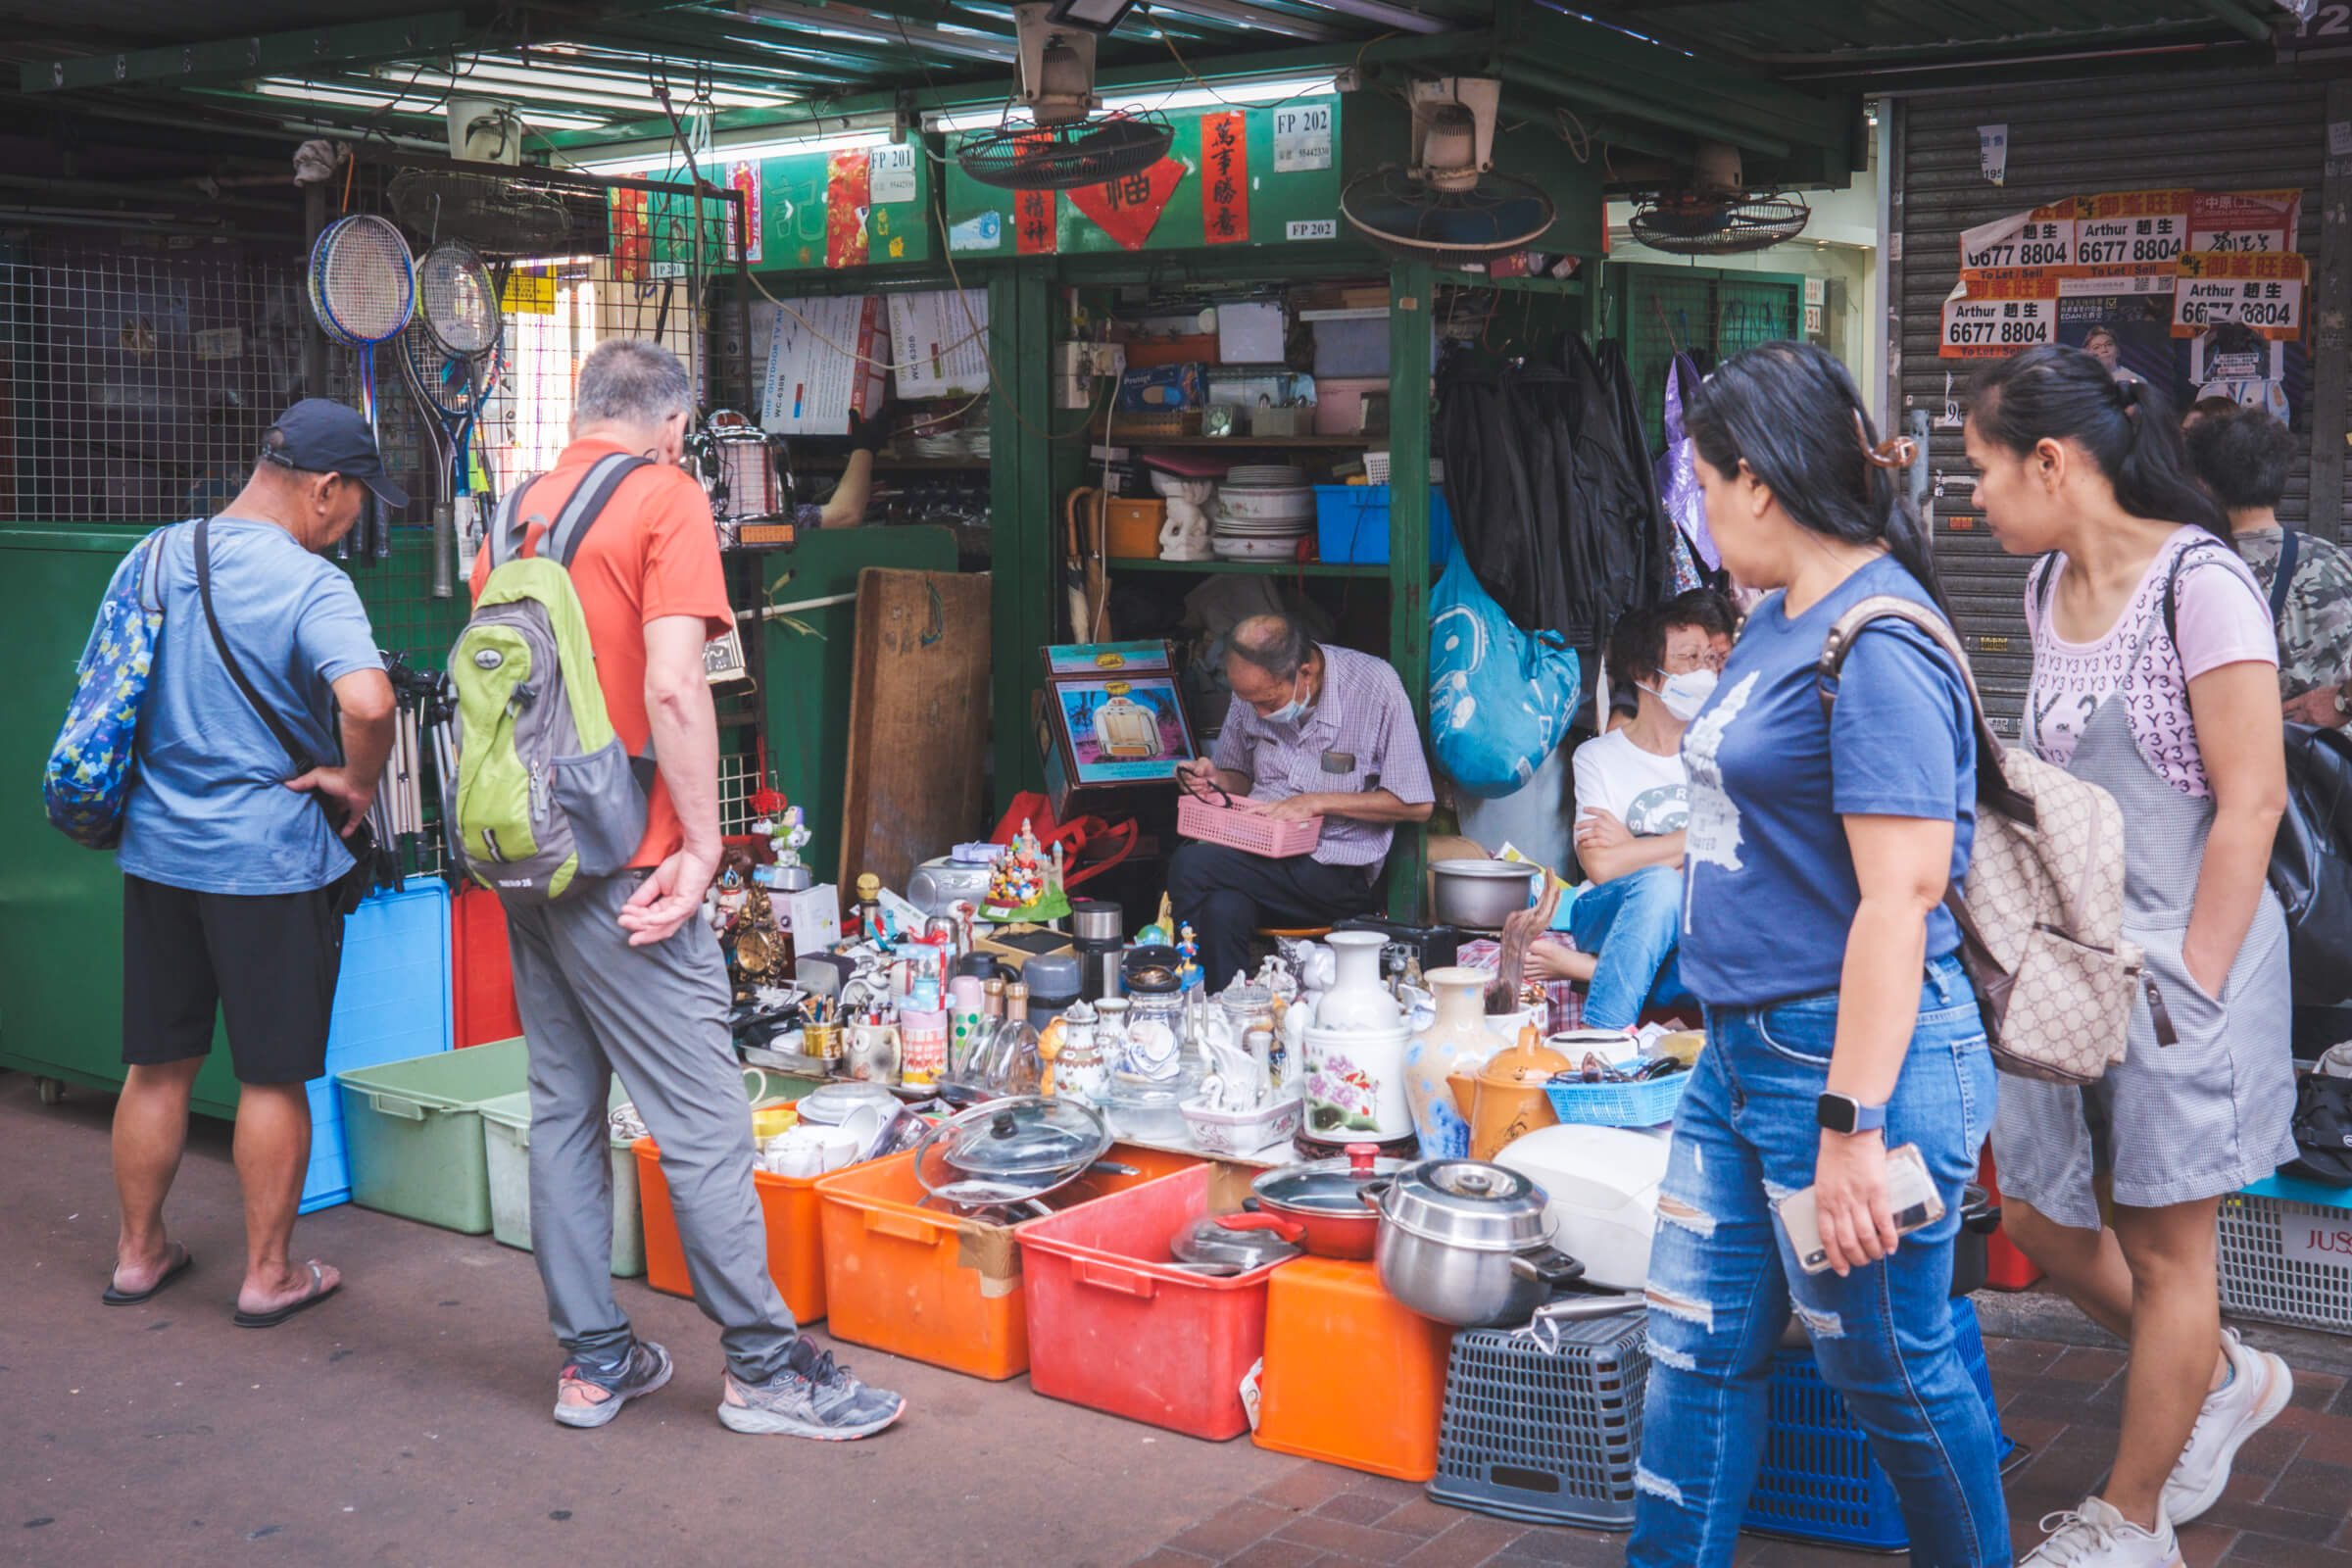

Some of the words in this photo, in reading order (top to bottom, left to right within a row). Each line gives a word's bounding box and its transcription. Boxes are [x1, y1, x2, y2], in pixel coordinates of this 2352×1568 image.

[1278, 115, 1296, 133] FP
[1303, 111, 1327, 131] 202
[871, 152, 886, 170] FP
[893, 149, 911, 168] 201
[1211, 118, 1239, 236] 萬事勝意
[1023, 189, 1048, 250] 精神
[1293, 224, 1307, 236] FP
[1311, 223, 1331, 235] 202
[2085, 224, 2128, 236] Arthur
[2021, 242, 2067, 265] 8804
[2079, 241, 2127, 263] 6677
[2133, 237, 2181, 261] 8804
[2190, 283, 2234, 296] Arthur
[1956, 306, 1995, 318] Arthur
[1950, 322, 1995, 343] 6677
[2001, 321, 2047, 342] 8804
[2118, 633, 2137, 650] Y3
[2066, 658, 2080, 673] Y3
[2084, 658, 2100, 672] Y3
[2105, 654, 2122, 670] Y3
[2069, 676, 2084, 692] Y3
[2090, 674, 2106, 691] Y3
[2113, 672, 2133, 690] Y3
[2143, 674, 2170, 689] Y3
[2126, 695, 2154, 710] Y3
[2146, 711, 2177, 727] Y3
[2154, 745, 2183, 760] Y3
[1630, 787, 1687, 831] SPOR
